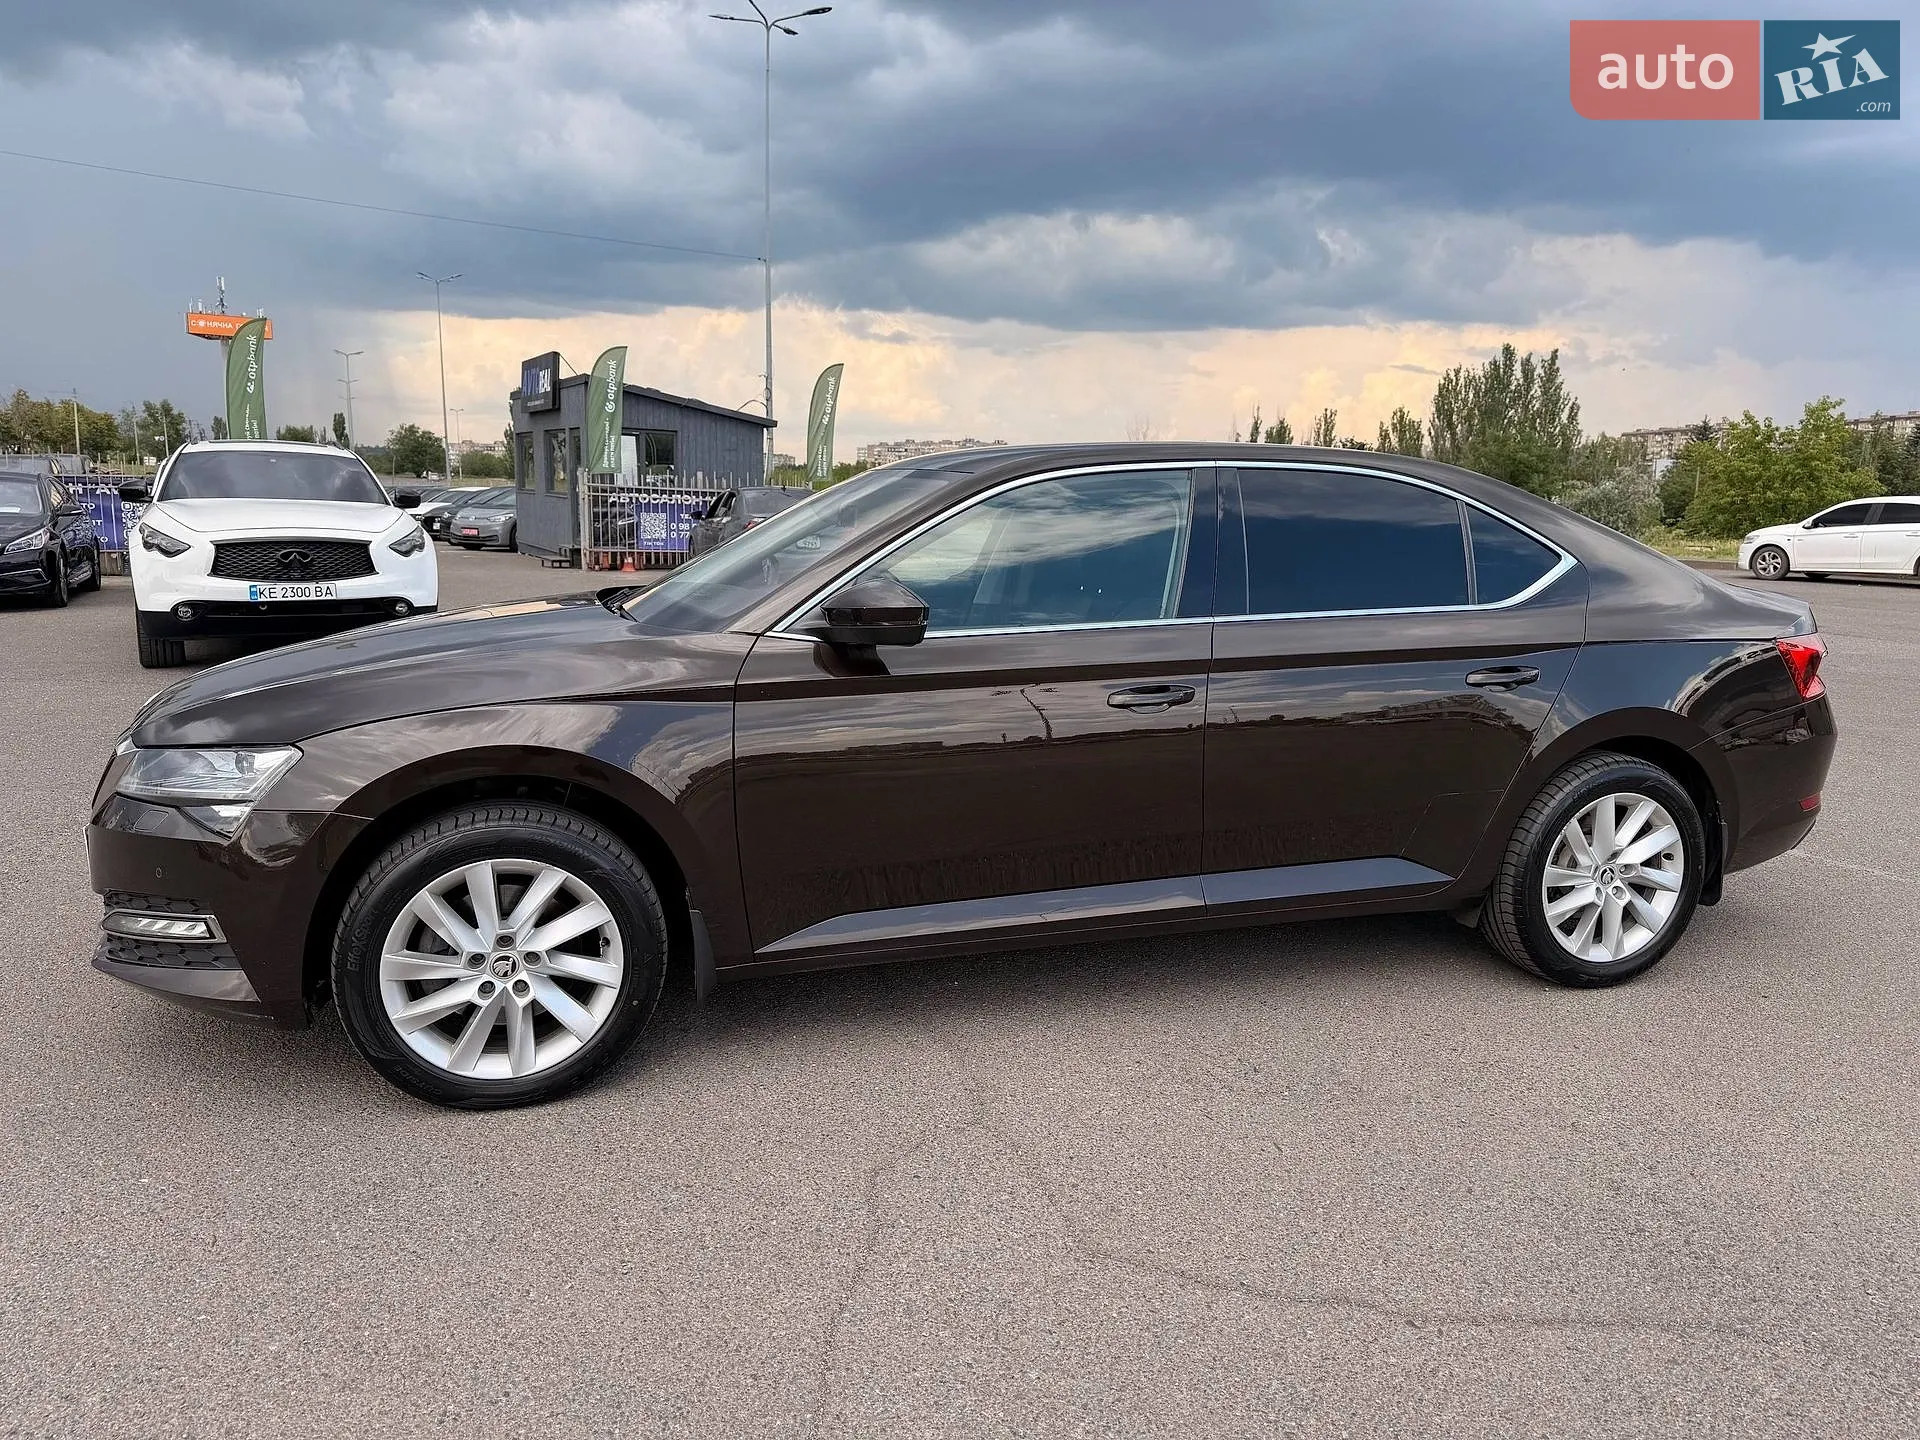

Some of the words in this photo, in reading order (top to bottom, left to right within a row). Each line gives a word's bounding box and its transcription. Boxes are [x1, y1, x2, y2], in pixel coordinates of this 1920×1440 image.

[246, 334, 258, 379] otpbank
[606, 359, 617, 400] otpbank
[609, 493, 703, 505] АВТОСАЛОН
[259, 587, 278, 599] KE
[281, 586, 311, 598] 2300
[315, 585, 334, 598] BA
